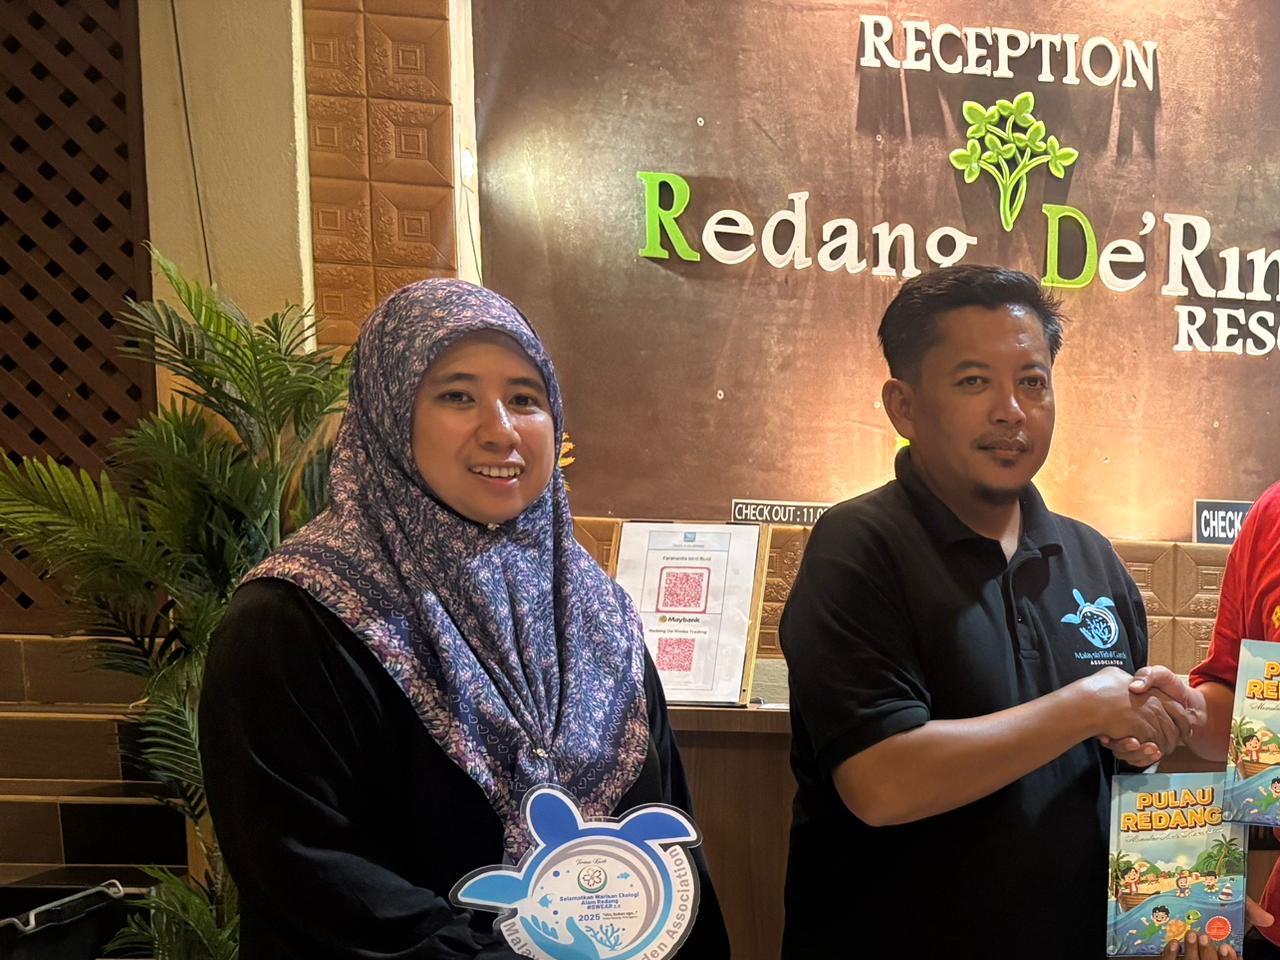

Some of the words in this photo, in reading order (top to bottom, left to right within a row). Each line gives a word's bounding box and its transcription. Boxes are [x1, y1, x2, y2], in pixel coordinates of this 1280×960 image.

[859, 15, 1157, 91] RECEPTION
[735, 504, 771, 521] CHECK
[772, 506, 796, 521] OUT
[803, 508, 828, 523] 11.0
[1201, 509, 1243, 538] CHECK
[1136, 787, 1214, 811] PULAU
[1120, 806, 1223, 832] REDANG
[667, 848, 691, 940] Association
